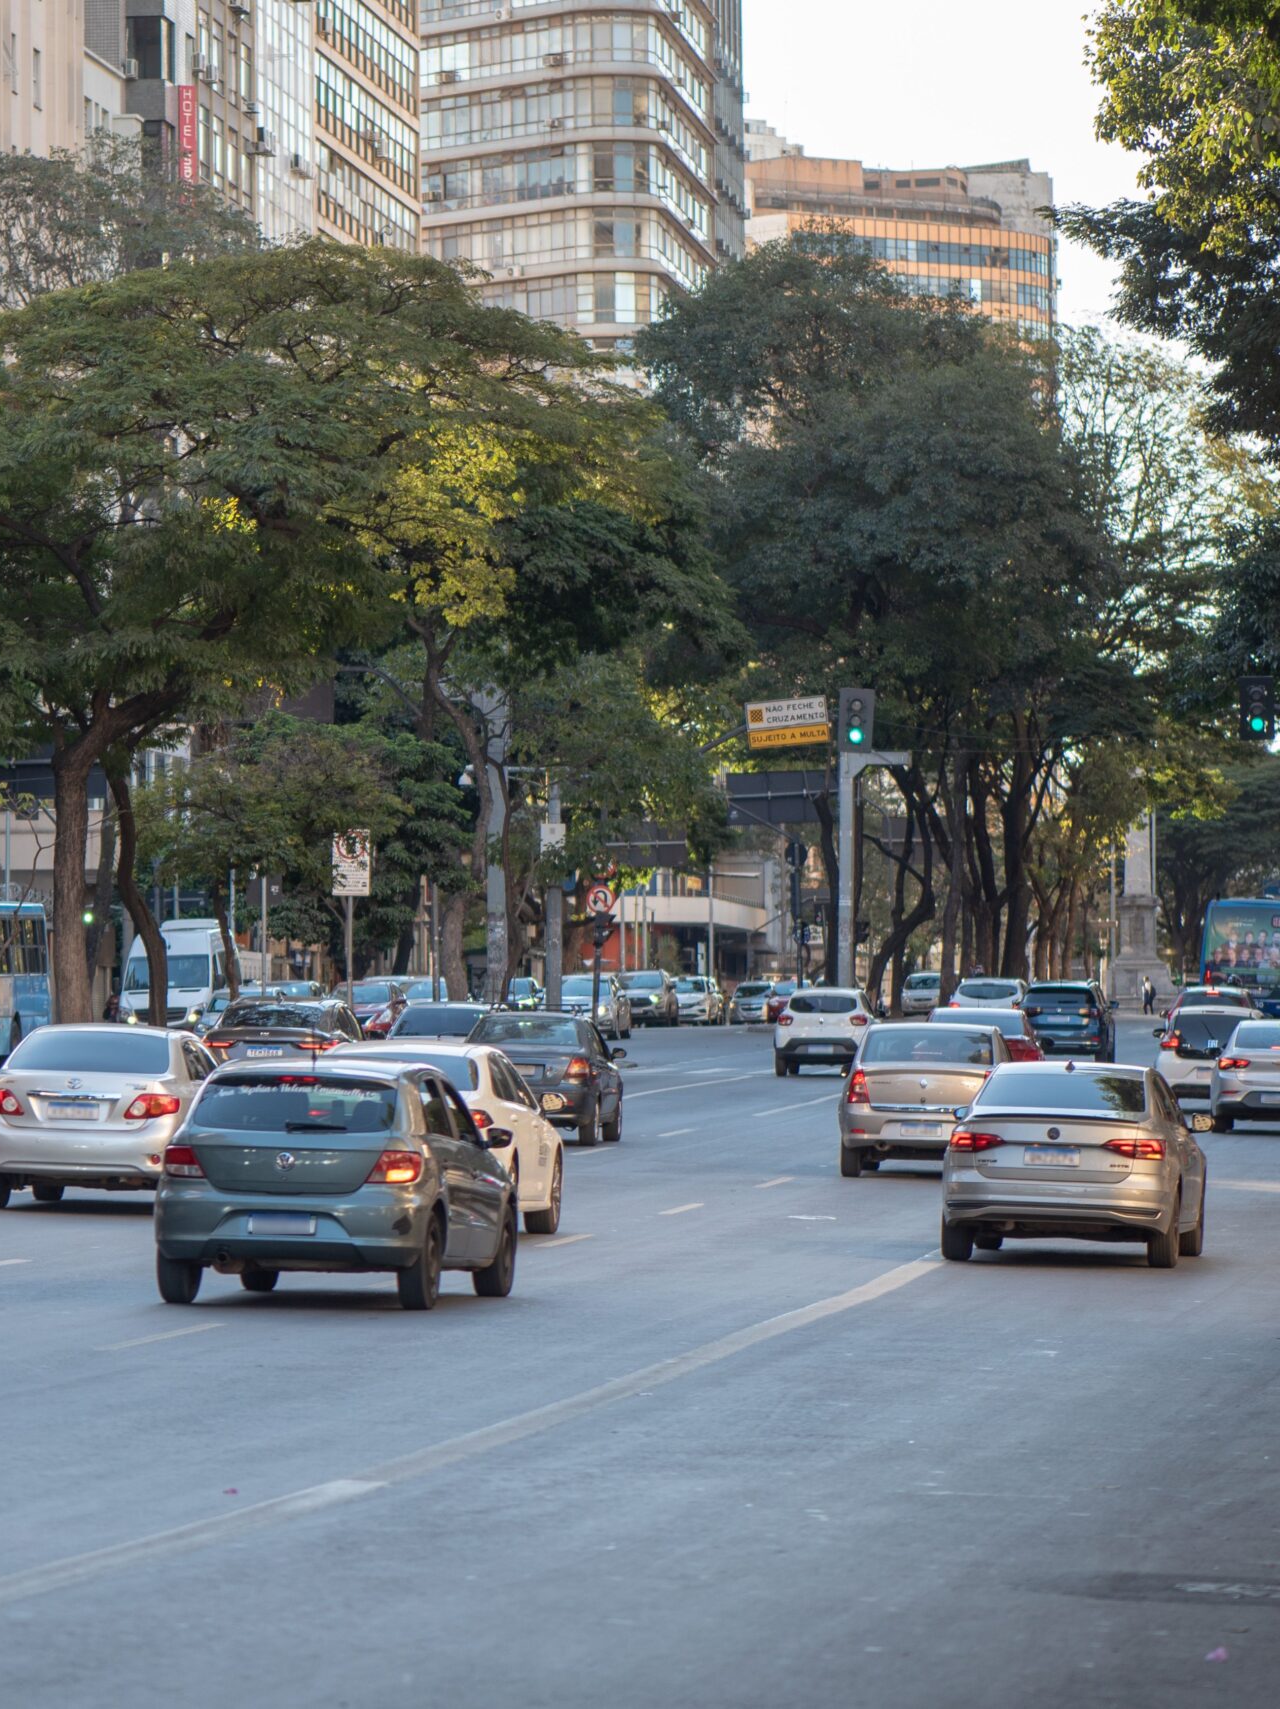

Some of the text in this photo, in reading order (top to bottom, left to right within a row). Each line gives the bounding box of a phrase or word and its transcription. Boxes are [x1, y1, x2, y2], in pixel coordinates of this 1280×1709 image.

[183, 89, 192, 148] HOTEL
[786, 702, 814, 711] FECHE
[767, 711, 825, 724] CRUZAMENTO
[751, 734, 787, 743] SUJEITO
[800, 730, 826, 738] MULTA
